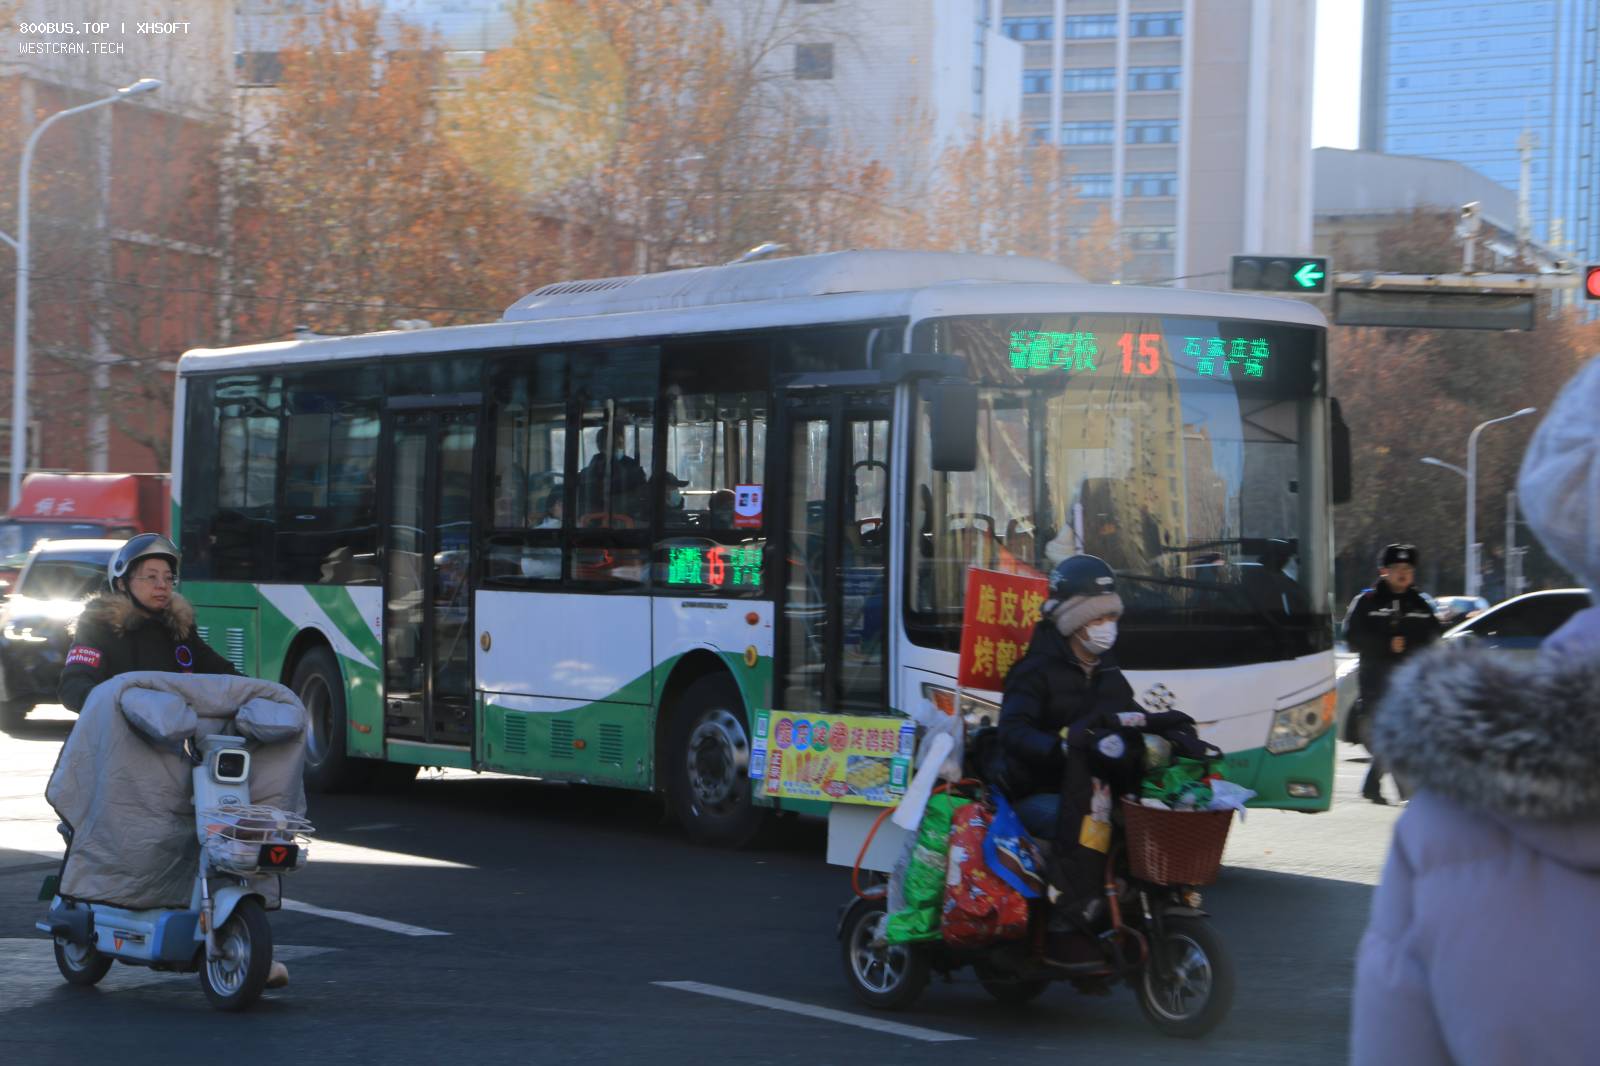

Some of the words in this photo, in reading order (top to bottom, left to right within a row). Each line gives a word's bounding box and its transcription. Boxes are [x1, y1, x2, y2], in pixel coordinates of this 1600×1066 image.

[1117, 332, 1162, 376] 15
[1183, 337, 1270, 358] 石家庄站
[1197, 357, 1264, 377] 西广场
[706, 547, 726, 586] 15
